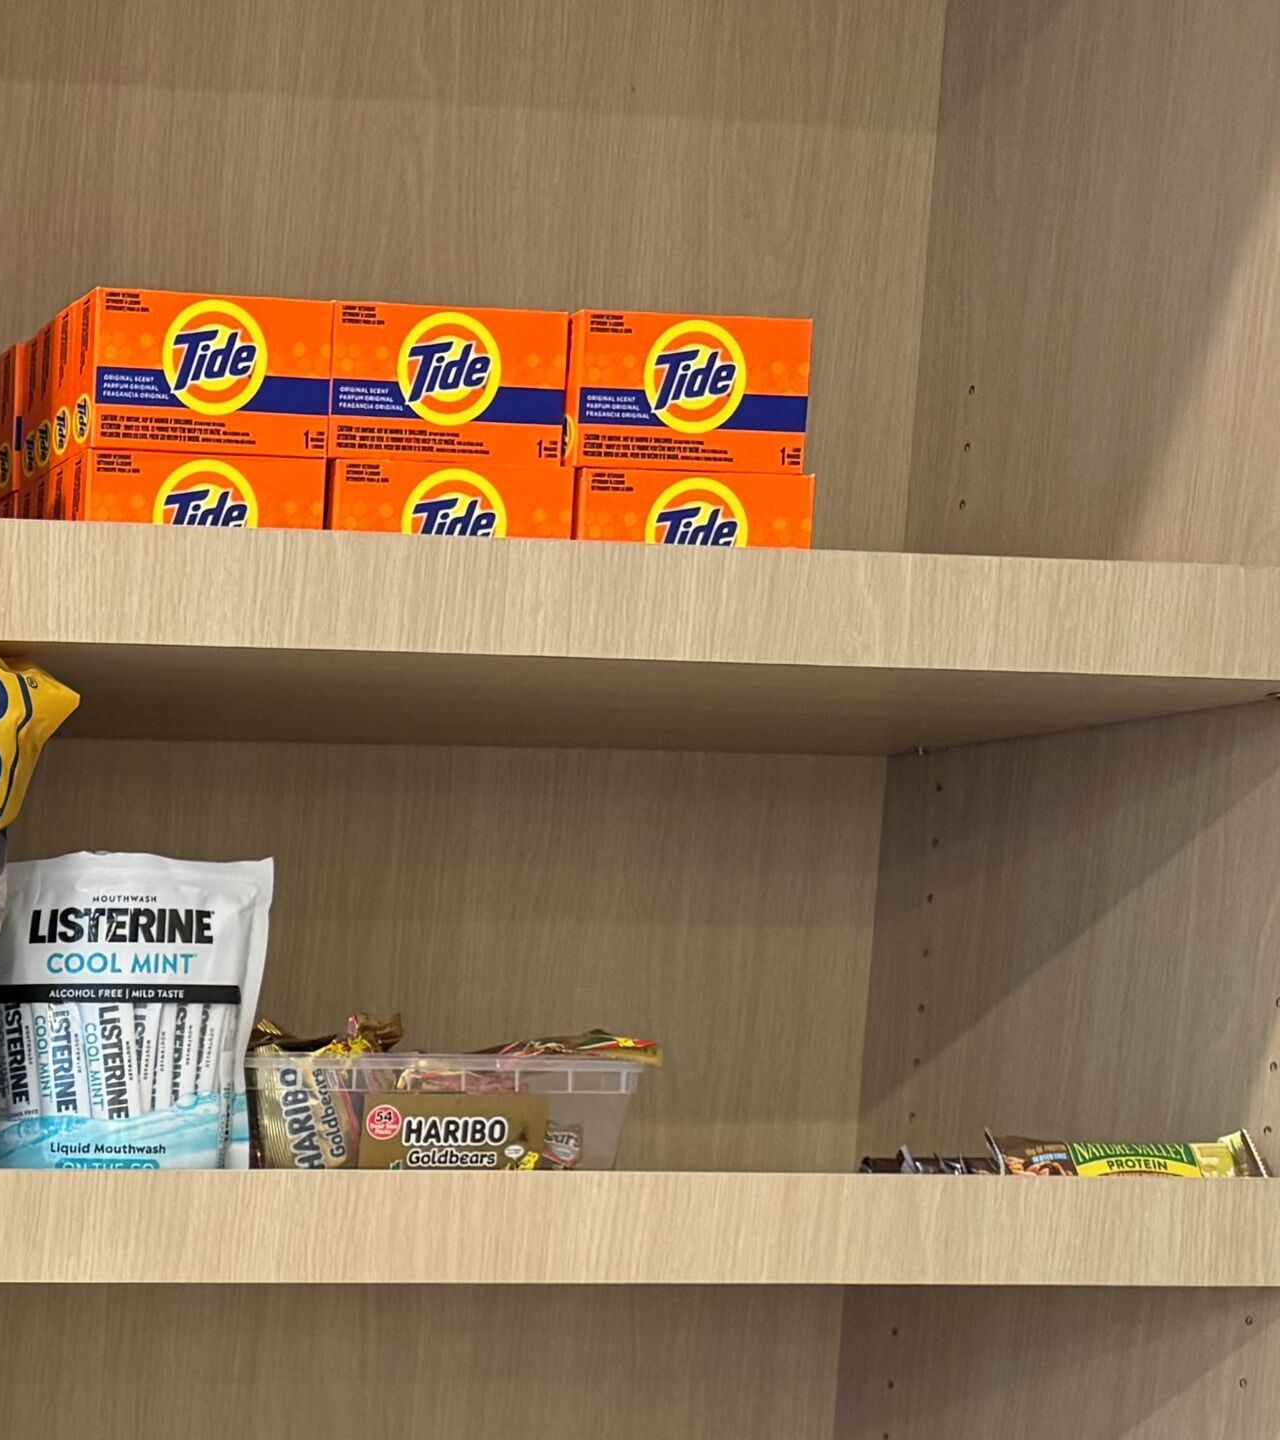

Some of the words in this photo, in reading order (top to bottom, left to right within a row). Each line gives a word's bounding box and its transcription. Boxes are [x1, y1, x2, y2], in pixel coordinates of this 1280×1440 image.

[169, 328, 259, 399] Tide
[404, 342, 492, 408] Tide
[651, 350, 738, 416] Tide
[92, 894, 158, 904] MOUTHWASH
[28, 907, 210, 945] LISTERINE
[46, 952, 122, 975] COOL
[130, 953, 194, 975] MINT
[48, 989, 96, 999] ALCOHOL
[98, 988, 123, 999] FREE
[131, 988, 155, 999] MILD
[157, 989, 185, 999] TASTE
[403, 1117, 508, 1145] HARIBO
[50, 1142, 91, 1156] Liquid
[93, 1142, 167, 1155] Mouthwash
[408, 1149, 497, 1167] Goldbears
[1107, 1157, 1168, 1172] PROTEIN
